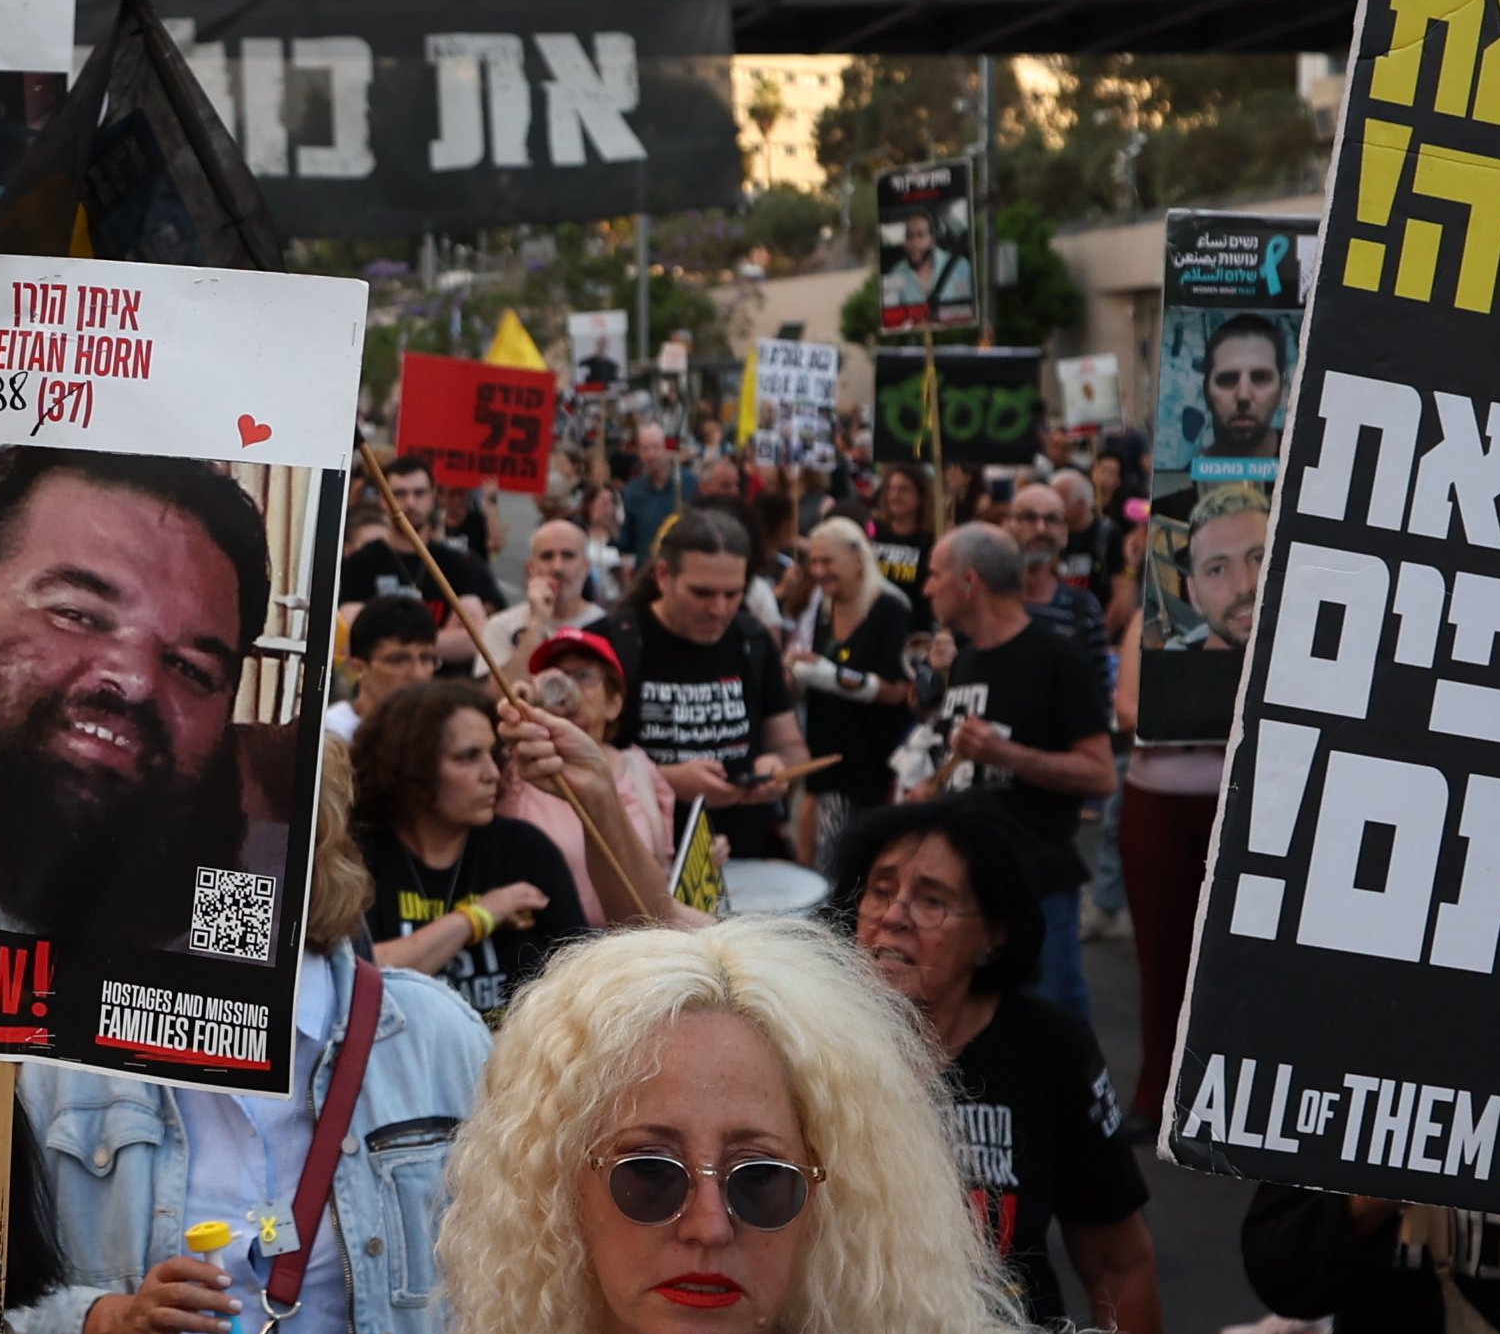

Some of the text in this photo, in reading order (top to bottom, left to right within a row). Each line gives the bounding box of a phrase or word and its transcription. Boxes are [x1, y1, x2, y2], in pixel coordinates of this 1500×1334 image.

[424, 31, 648, 174] את
[1218, 251, 1259, 267] עושות
[1228, 234, 1259, 250] נשים
[1225, 267, 1258, 284] שלום
[11, 280, 142, 335] איתן הורן
[74, 335, 153, 380] HORN
[34, 380, 95, 434] (37)
[474, 398, 542, 454] כל
[101, 980, 269, 1030] HOSTAGES AND MISSING
[98, 1003, 268, 1064] FAMILIES FORUM
[1182, 1051, 1302, 1155] ALL
